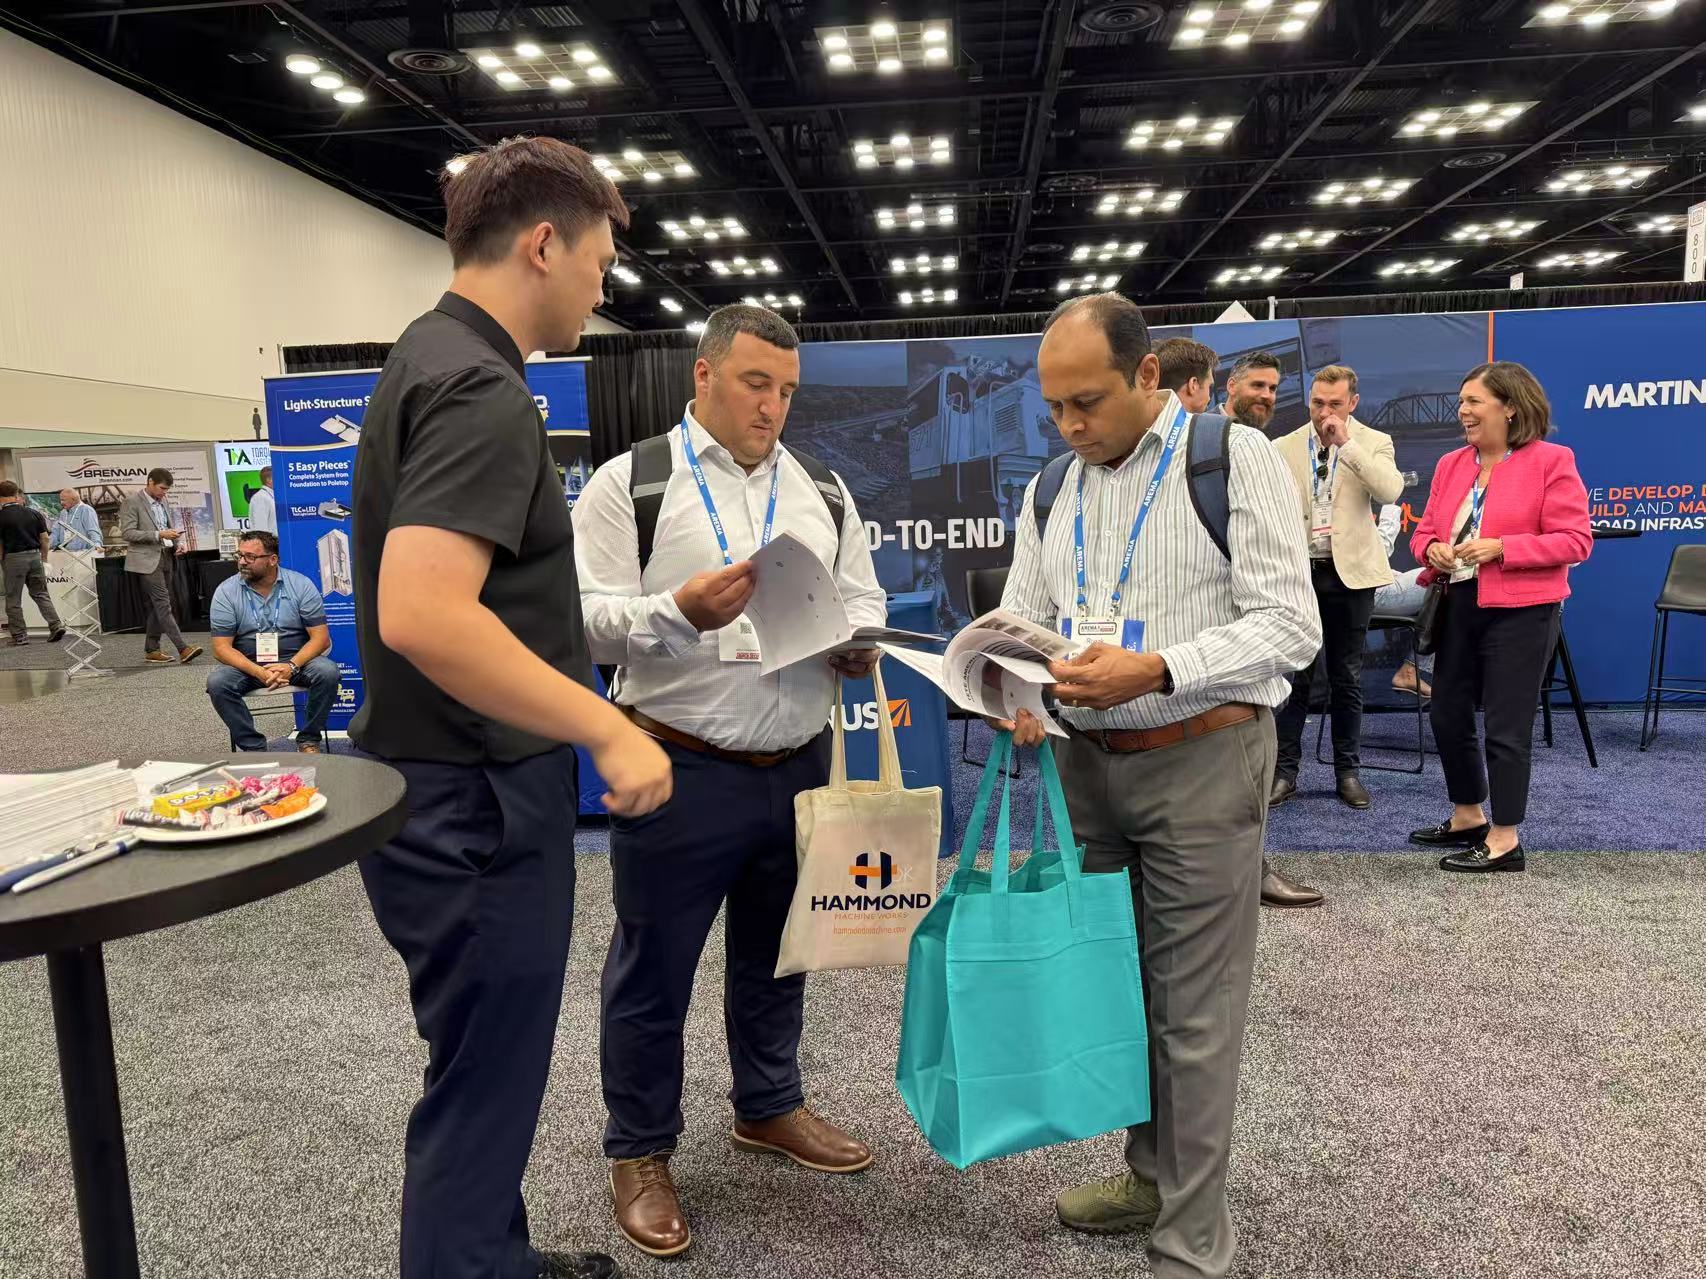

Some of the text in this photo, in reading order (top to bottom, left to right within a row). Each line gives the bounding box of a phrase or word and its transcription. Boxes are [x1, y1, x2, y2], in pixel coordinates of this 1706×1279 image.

[1584, 379, 1706, 409] MARTIN
[1167, 426, 1180, 449] AREMA
[84, 468, 147, 478] BRENNAN
[288, 462, 294, 472] 5
[296, 462, 317, 473] Easy
[692, 464, 705, 486] AREMA
[1144, 480, 1159, 506] AREMA
[1587, 487, 1603, 501] E
[1609, 484, 1696, 500] DEVELOP,
[1634, 501, 1674, 515] AND
[710, 512, 723, 536] AREMA
[1076, 545, 1084, 573] AREMA
[1124, 539, 1136, 568] AREMA
[810, 893, 931, 912] HAMMOND
[834, 911, 909, 921] MACHINE WORKS
